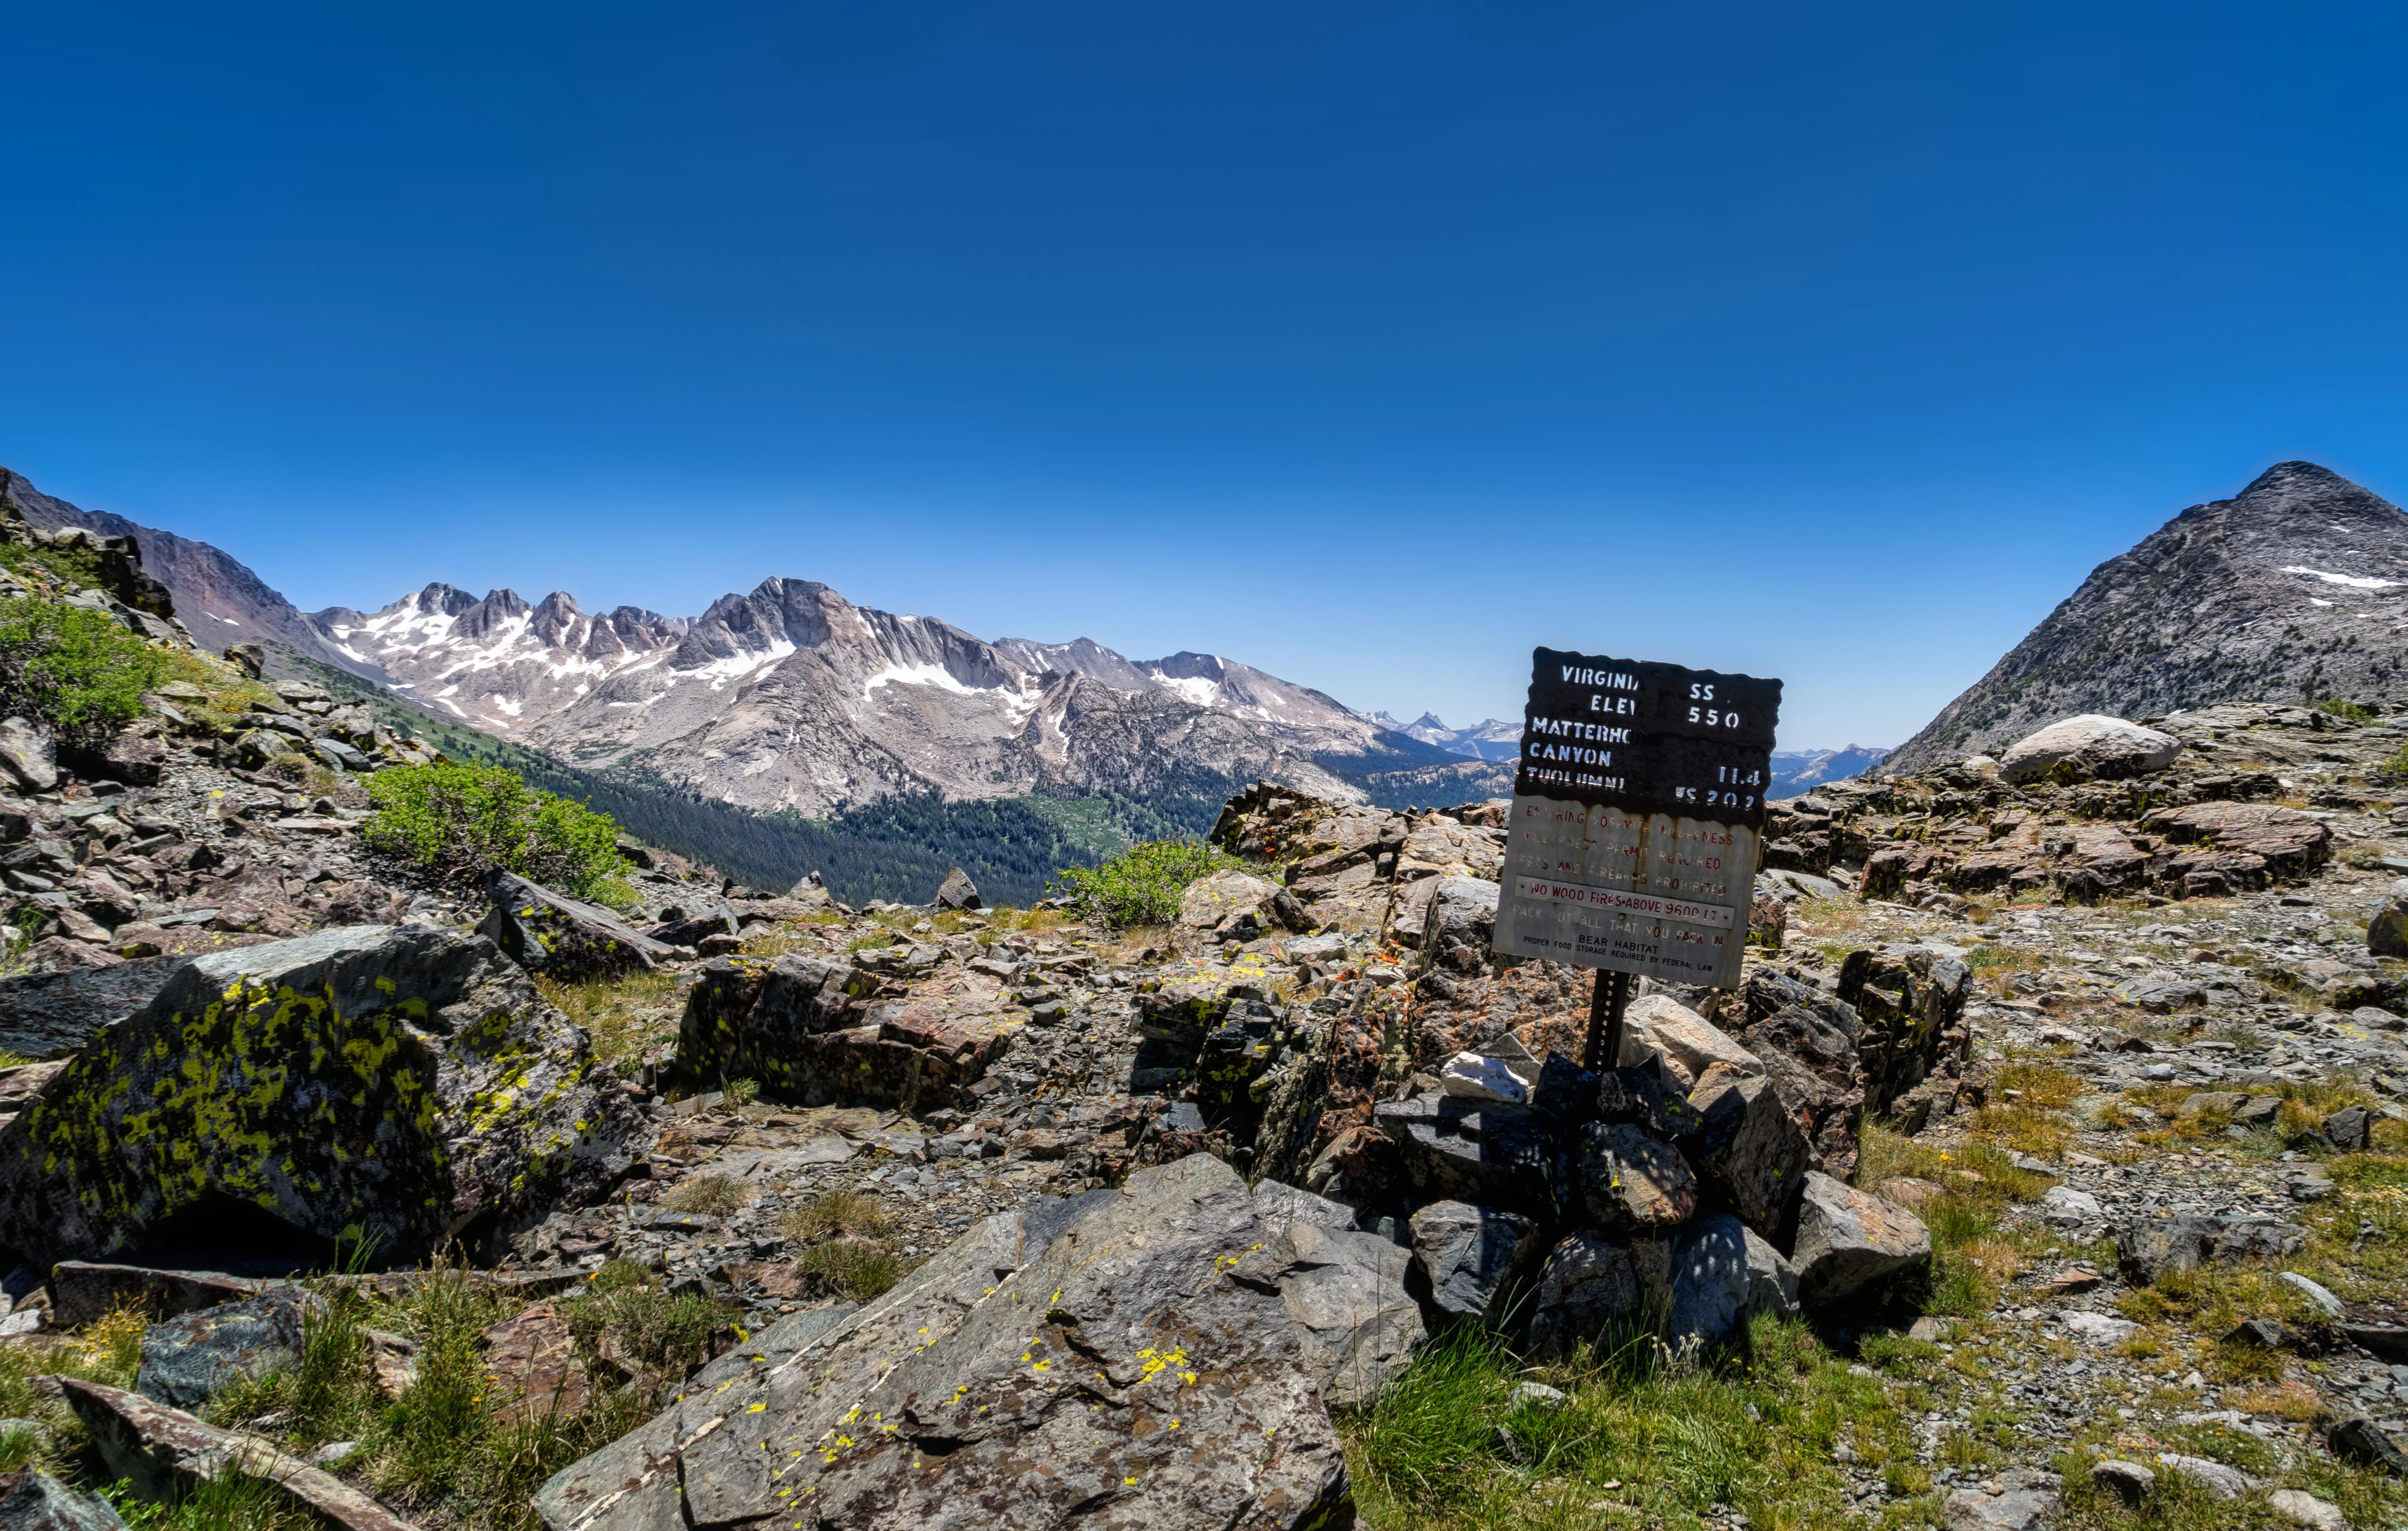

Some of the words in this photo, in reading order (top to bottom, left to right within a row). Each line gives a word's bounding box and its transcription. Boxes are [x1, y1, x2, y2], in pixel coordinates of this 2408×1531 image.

[1530, 742, 1611, 766] CANYON
[1719, 766, 1760, 786] 11.4
[1527, 805, 1584, 824] ENTERING
[1593, 815, 1649, 833] YOSEMITE
[1658, 824, 1733, 845] WILDERNESS
[1524, 830, 1597, 851] WILDERNESS
[1607, 843, 1648, 857] PERMIT
[1659, 851, 1721, 870] REQUIRED
[1519, 854, 1549, 870] PETS
[1558, 861, 1581, 874] AND
[1589, 866, 1648, 885] FIREARMS
[1656, 876, 1725, 896] PROHIBITED
[1531, 883, 1547, 895] NO
[1553, 886, 1584, 900] WOOD
[1591, 892, 1622, 907] FIRES
[1626, 898, 1661, 912] ABOVE
[1666, 903, 1699, 918] 9600
[1704, 910, 1717, 921] FT
[1513, 903, 1543, 919] PACK
[1550, 910, 1573, 923] OUT
[1581, 916, 1601, 929] ALL
[1611, 920, 1638, 934] THAT
[1646, 925, 1669, 939] YOU
[1677, 930, 1704, 944] PACK
[1712, 936, 1723, 946] IN
[1579, 935, 1608, 947] BEAR
[1615, 940, 1659, 954] HABITAT
[1524, 936, 1550, 947] PROPER
[1554, 941, 1572, 950] FOOD
[1576, 945, 1607, 955] STORAGE
[1611, 950, 1645, 961] REQUIRED
[1662, 958, 1692, 969] FEDERAL
